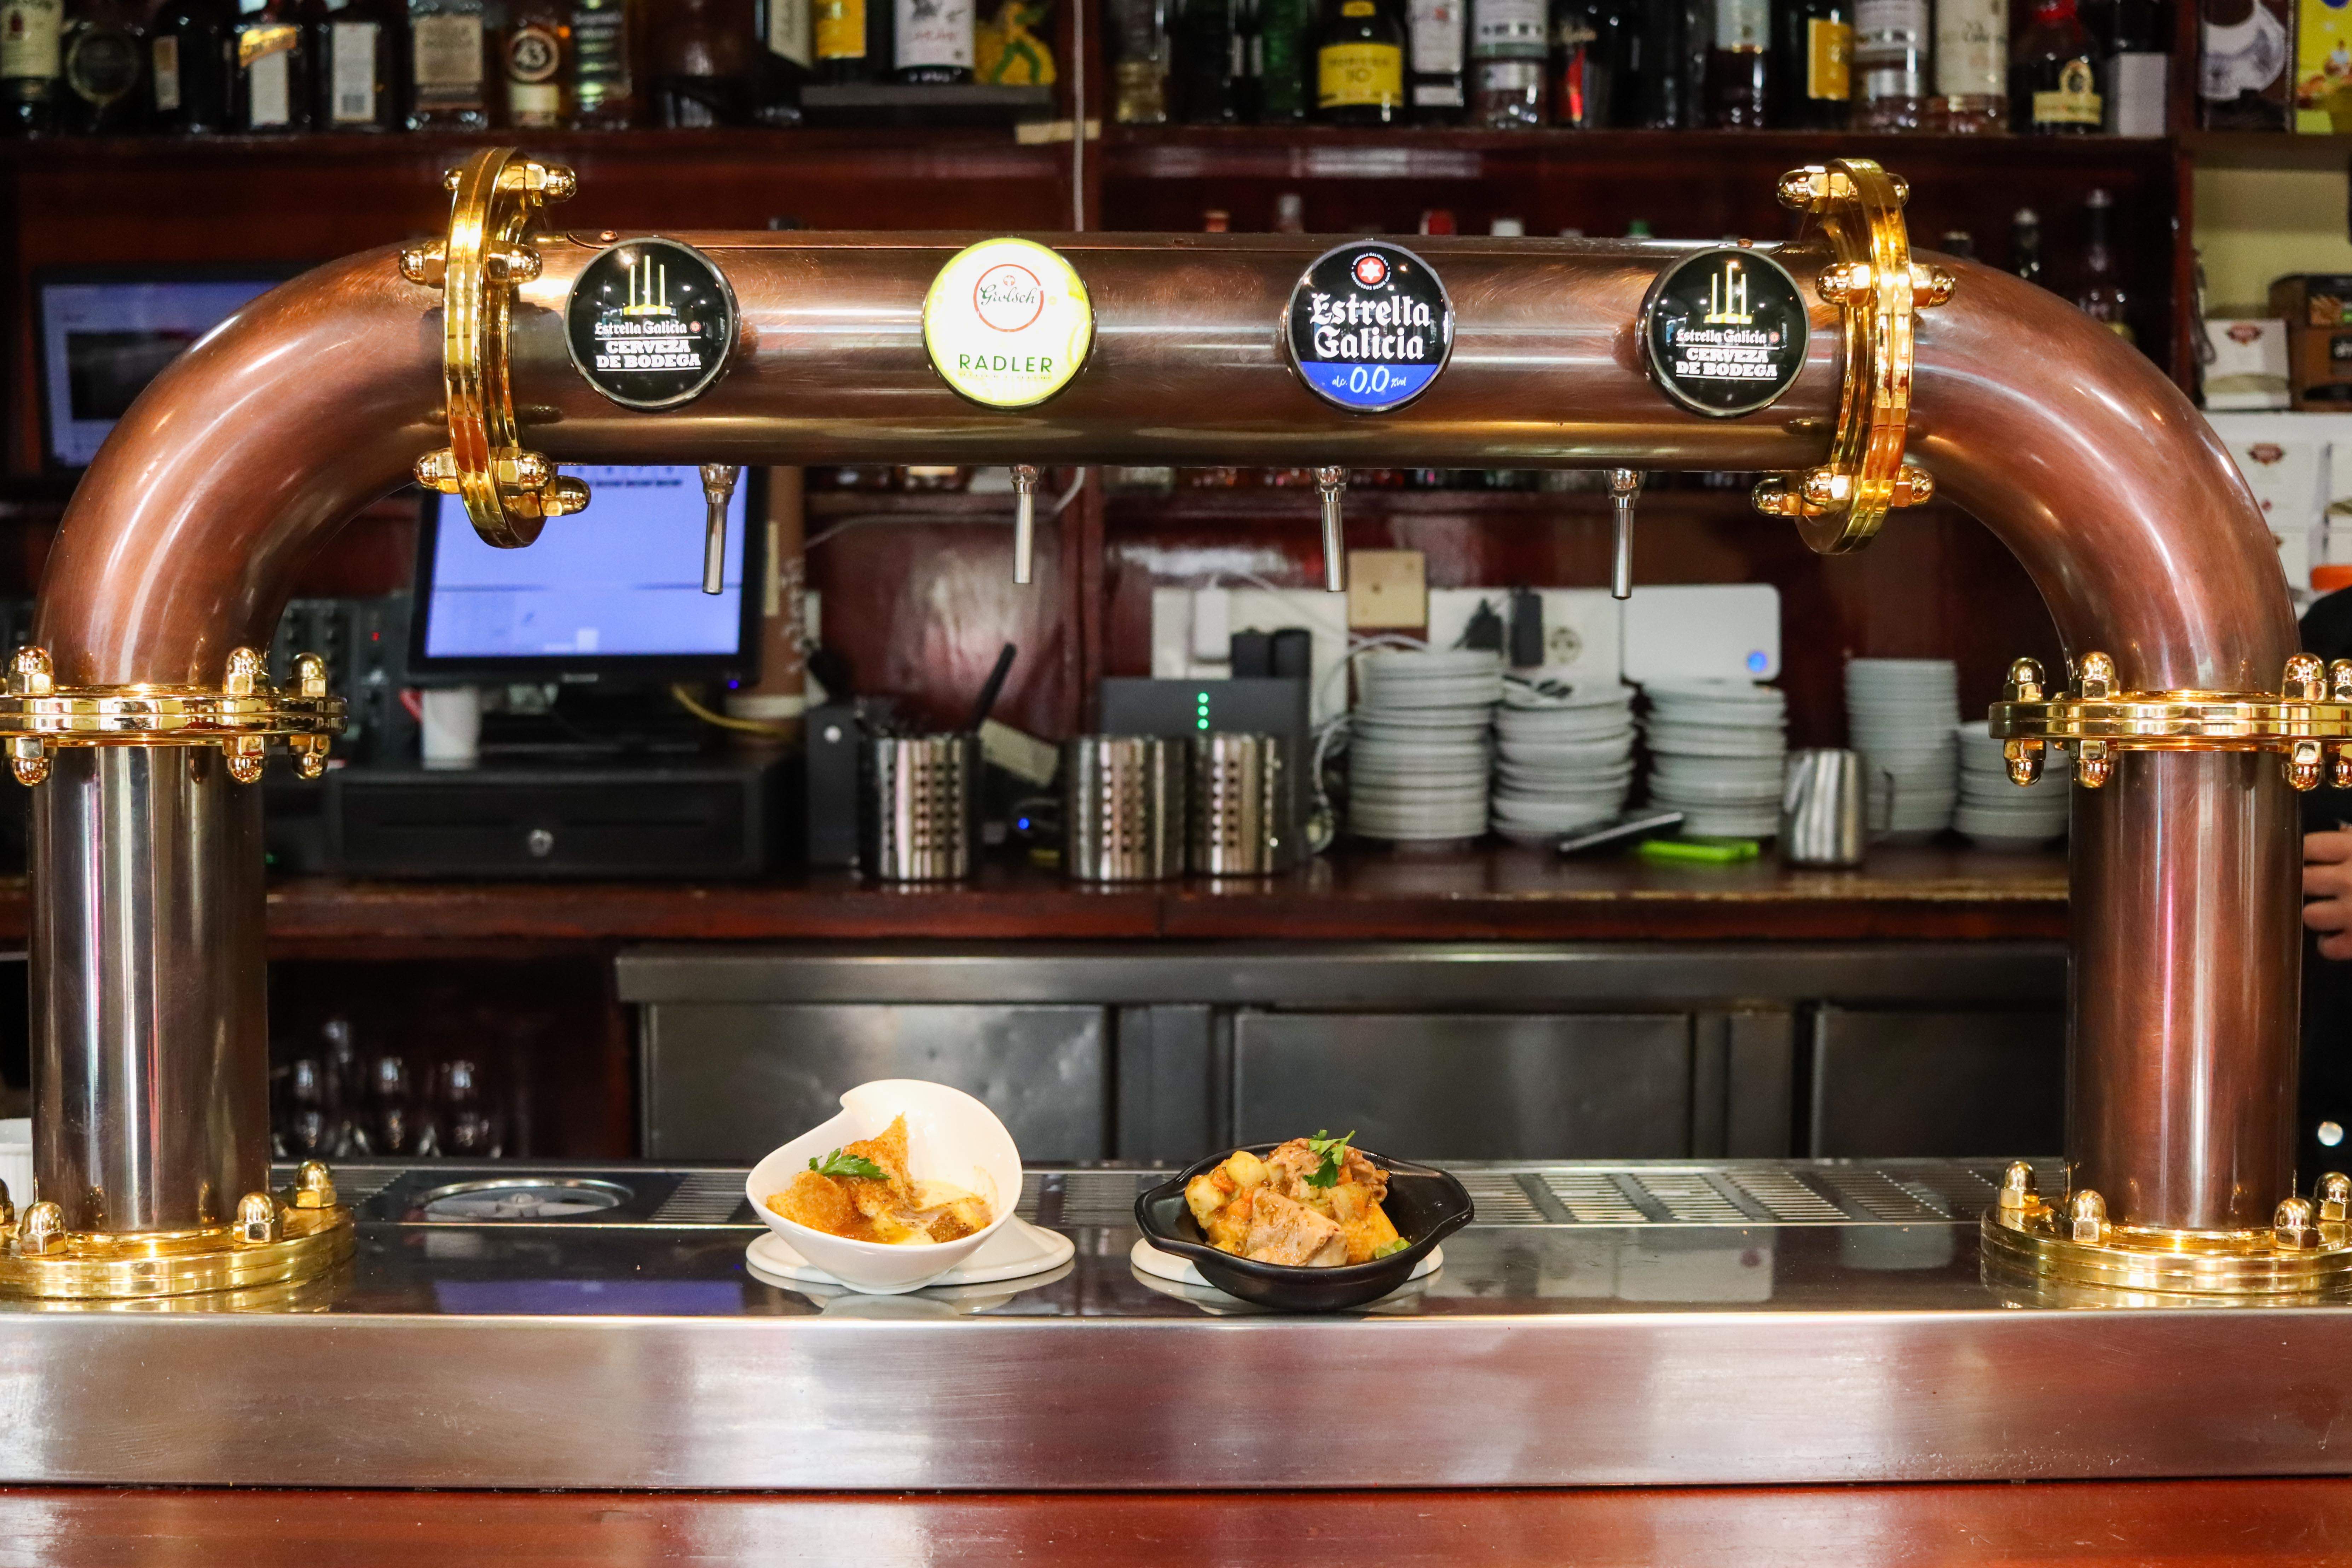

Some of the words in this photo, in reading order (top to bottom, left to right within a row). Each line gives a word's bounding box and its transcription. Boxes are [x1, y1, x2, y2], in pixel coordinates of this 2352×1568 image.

[1369, 252, 1384, 261] GALICIA
[980, 284, 1037, 306] Grolsch
[1310, 293, 1431, 327] Estrella
[595, 322, 641, 335] Estrella
[643, 320, 687, 334] Galicia
[1314, 325, 1425, 359] Galicia
[1676, 329, 1722, 343] Estrella
[1723, 329, 1767, 344] Galicia
[606, 340, 690, 354] CERVEZA
[1686, 347, 1769, 363] CERVEZA
[596, 355, 621, 368] DE
[624, 354, 701, 368] BODEGA
[960, 354, 1052, 372] RADLER
[1676, 361, 1700, 374] DE
[1703, 363, 1778, 377] BODEGA
[1332, 375, 1348, 388] alc.
[1350, 365, 1389, 394] 0,0
